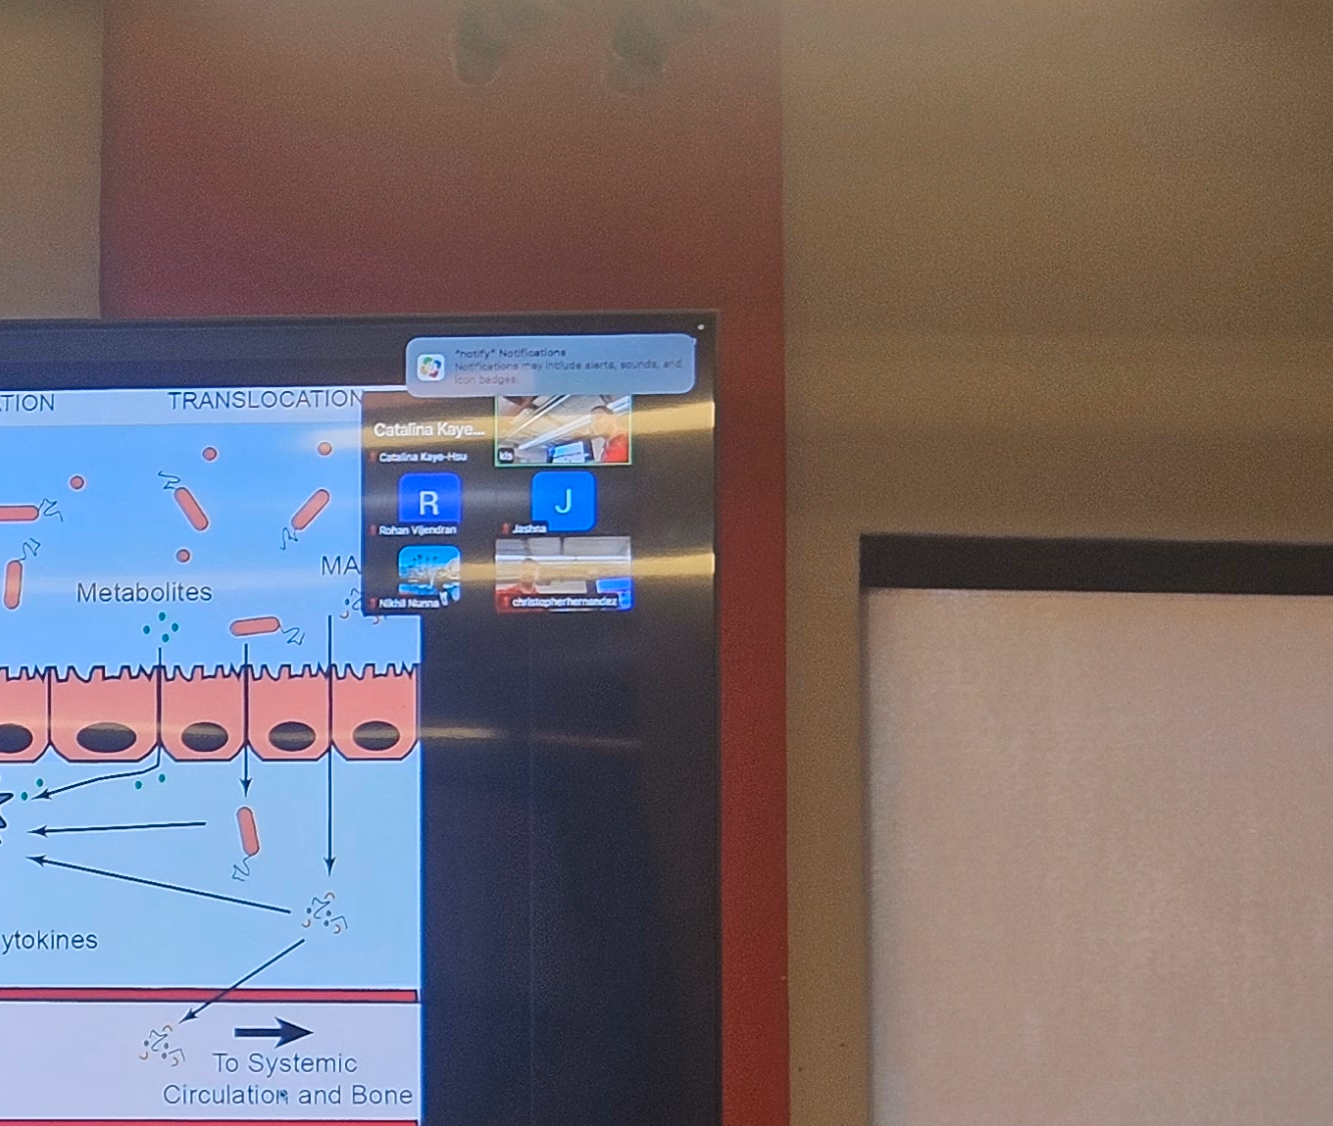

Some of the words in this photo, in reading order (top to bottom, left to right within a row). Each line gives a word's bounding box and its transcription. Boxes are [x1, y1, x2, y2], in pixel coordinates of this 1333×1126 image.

[499, 347, 566, 358] Notifications
[455, 361, 518, 371] Notifications
[546, 360, 581, 370] include
[168, 388, 363, 411] TRANSLOCATION
[373, 422, 433, 437] Catalina
[379, 452, 418, 462] Catalina
[420, 452, 468, 463] Kaye-Hsu
[419, 491, 440, 516] R
[554, 488, 572, 514] J
[379, 525, 409, 536] Rohan
[76, 580, 212, 604] Metabolites
[212, 1052, 240, 1073] To
[248, 1051, 358, 1079] Systemic
[163, 1084, 289, 1106] Circulation
[298, 1084, 342, 1106] and
[351, 1084, 413, 1106] Bone
